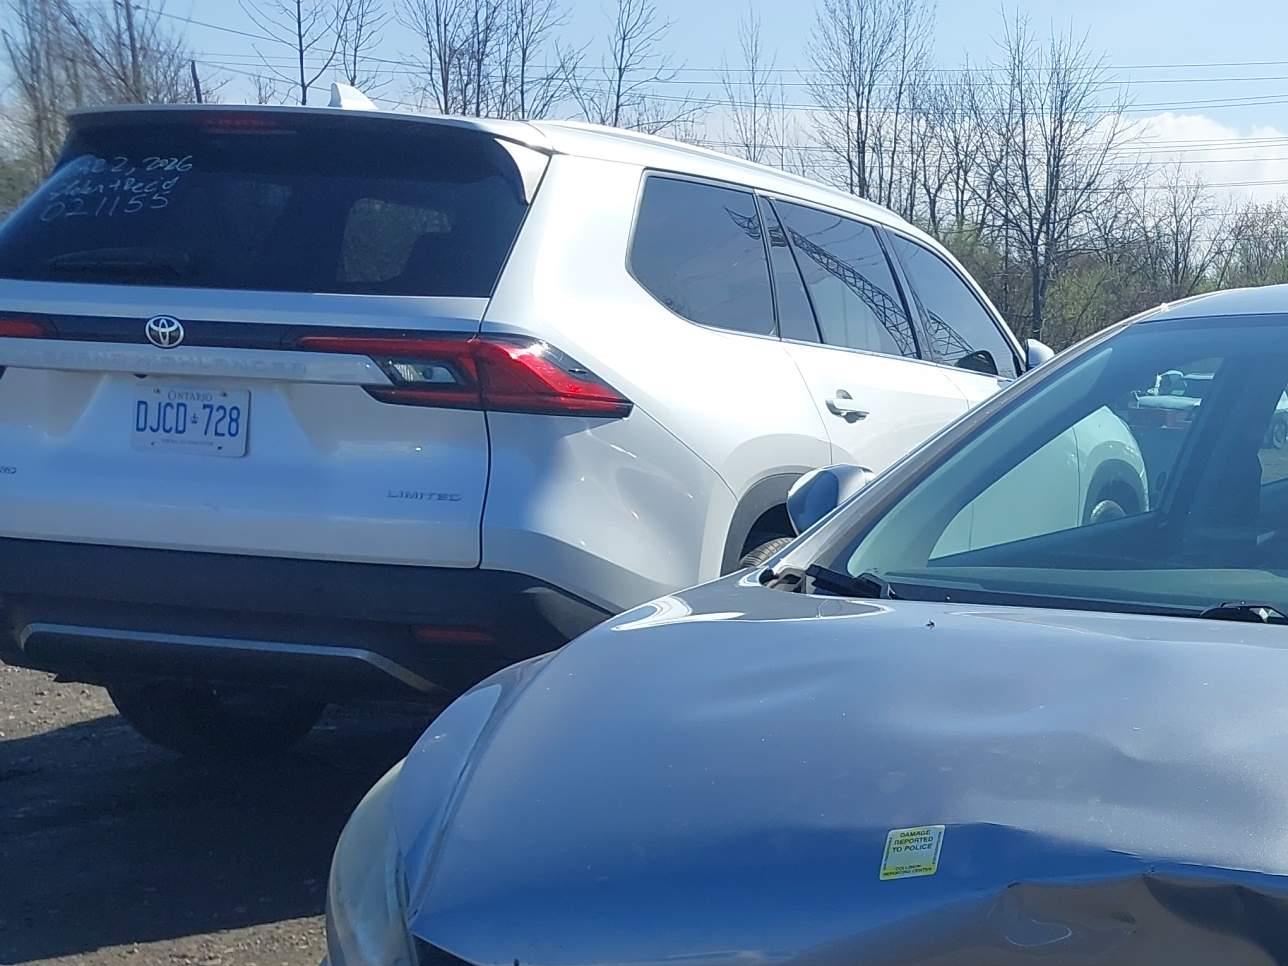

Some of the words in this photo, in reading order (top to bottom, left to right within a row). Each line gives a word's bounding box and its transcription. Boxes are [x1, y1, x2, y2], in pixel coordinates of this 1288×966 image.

[135, 400, 188, 434] DJCD
[202, 403, 241, 438] 728
[386, 489, 463, 502] LIMITED
[900, 830, 931, 838] DAMAGE
[894, 836, 934, 846] REPORTED
[904, 843, 933, 852] POLICE
